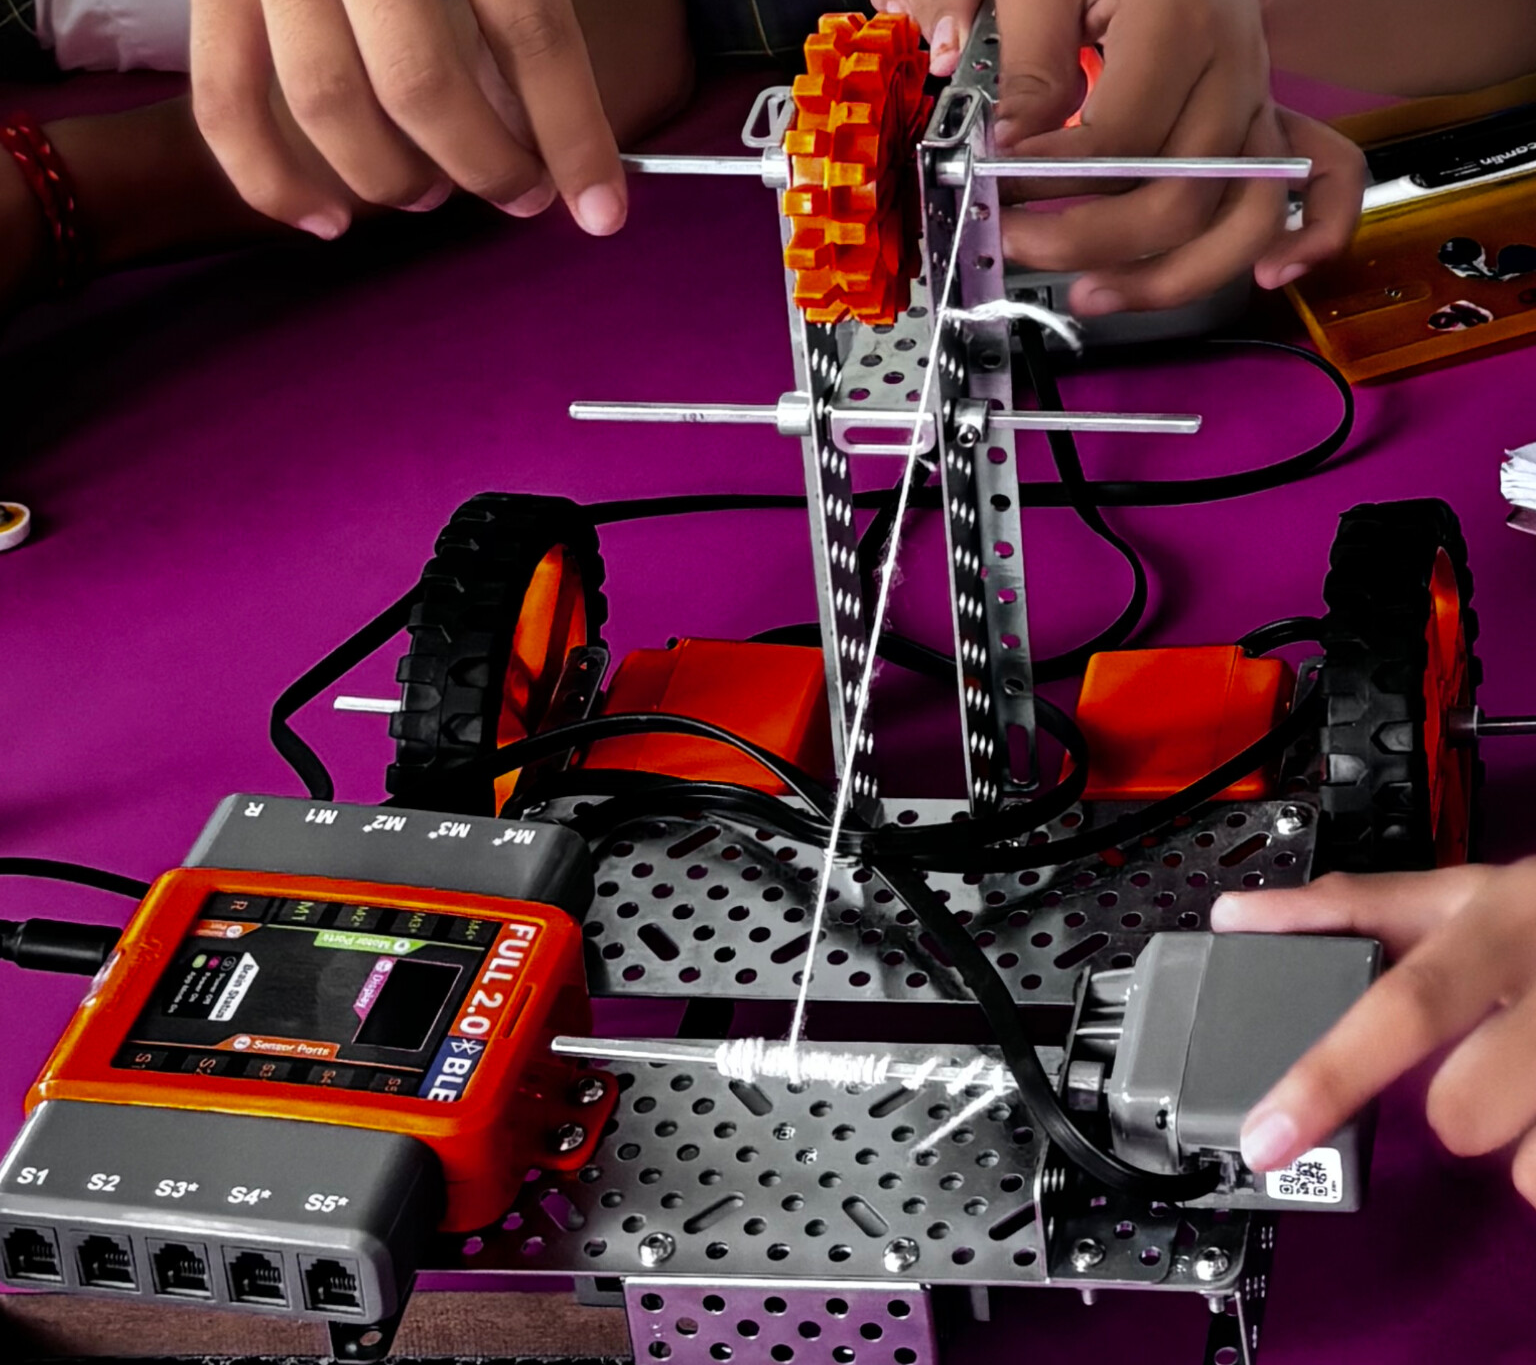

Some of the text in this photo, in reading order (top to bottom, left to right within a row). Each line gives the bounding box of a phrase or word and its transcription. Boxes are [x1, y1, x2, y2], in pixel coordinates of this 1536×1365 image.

[244, 802, 264, 818] R
[305, 808, 339, 824] M1
[459, 923, 538, 1035] FULL 2.0
[216, 964, 254, 1019] Brain Status
[357, 973, 384, 1009] Display
[252, 1040, 330, 1056] Sensor Ports
[427, 1057, 473, 1103] BLE
[16, 1167, 50, 1186] S1
[87, 1173, 121, 1192] S2
